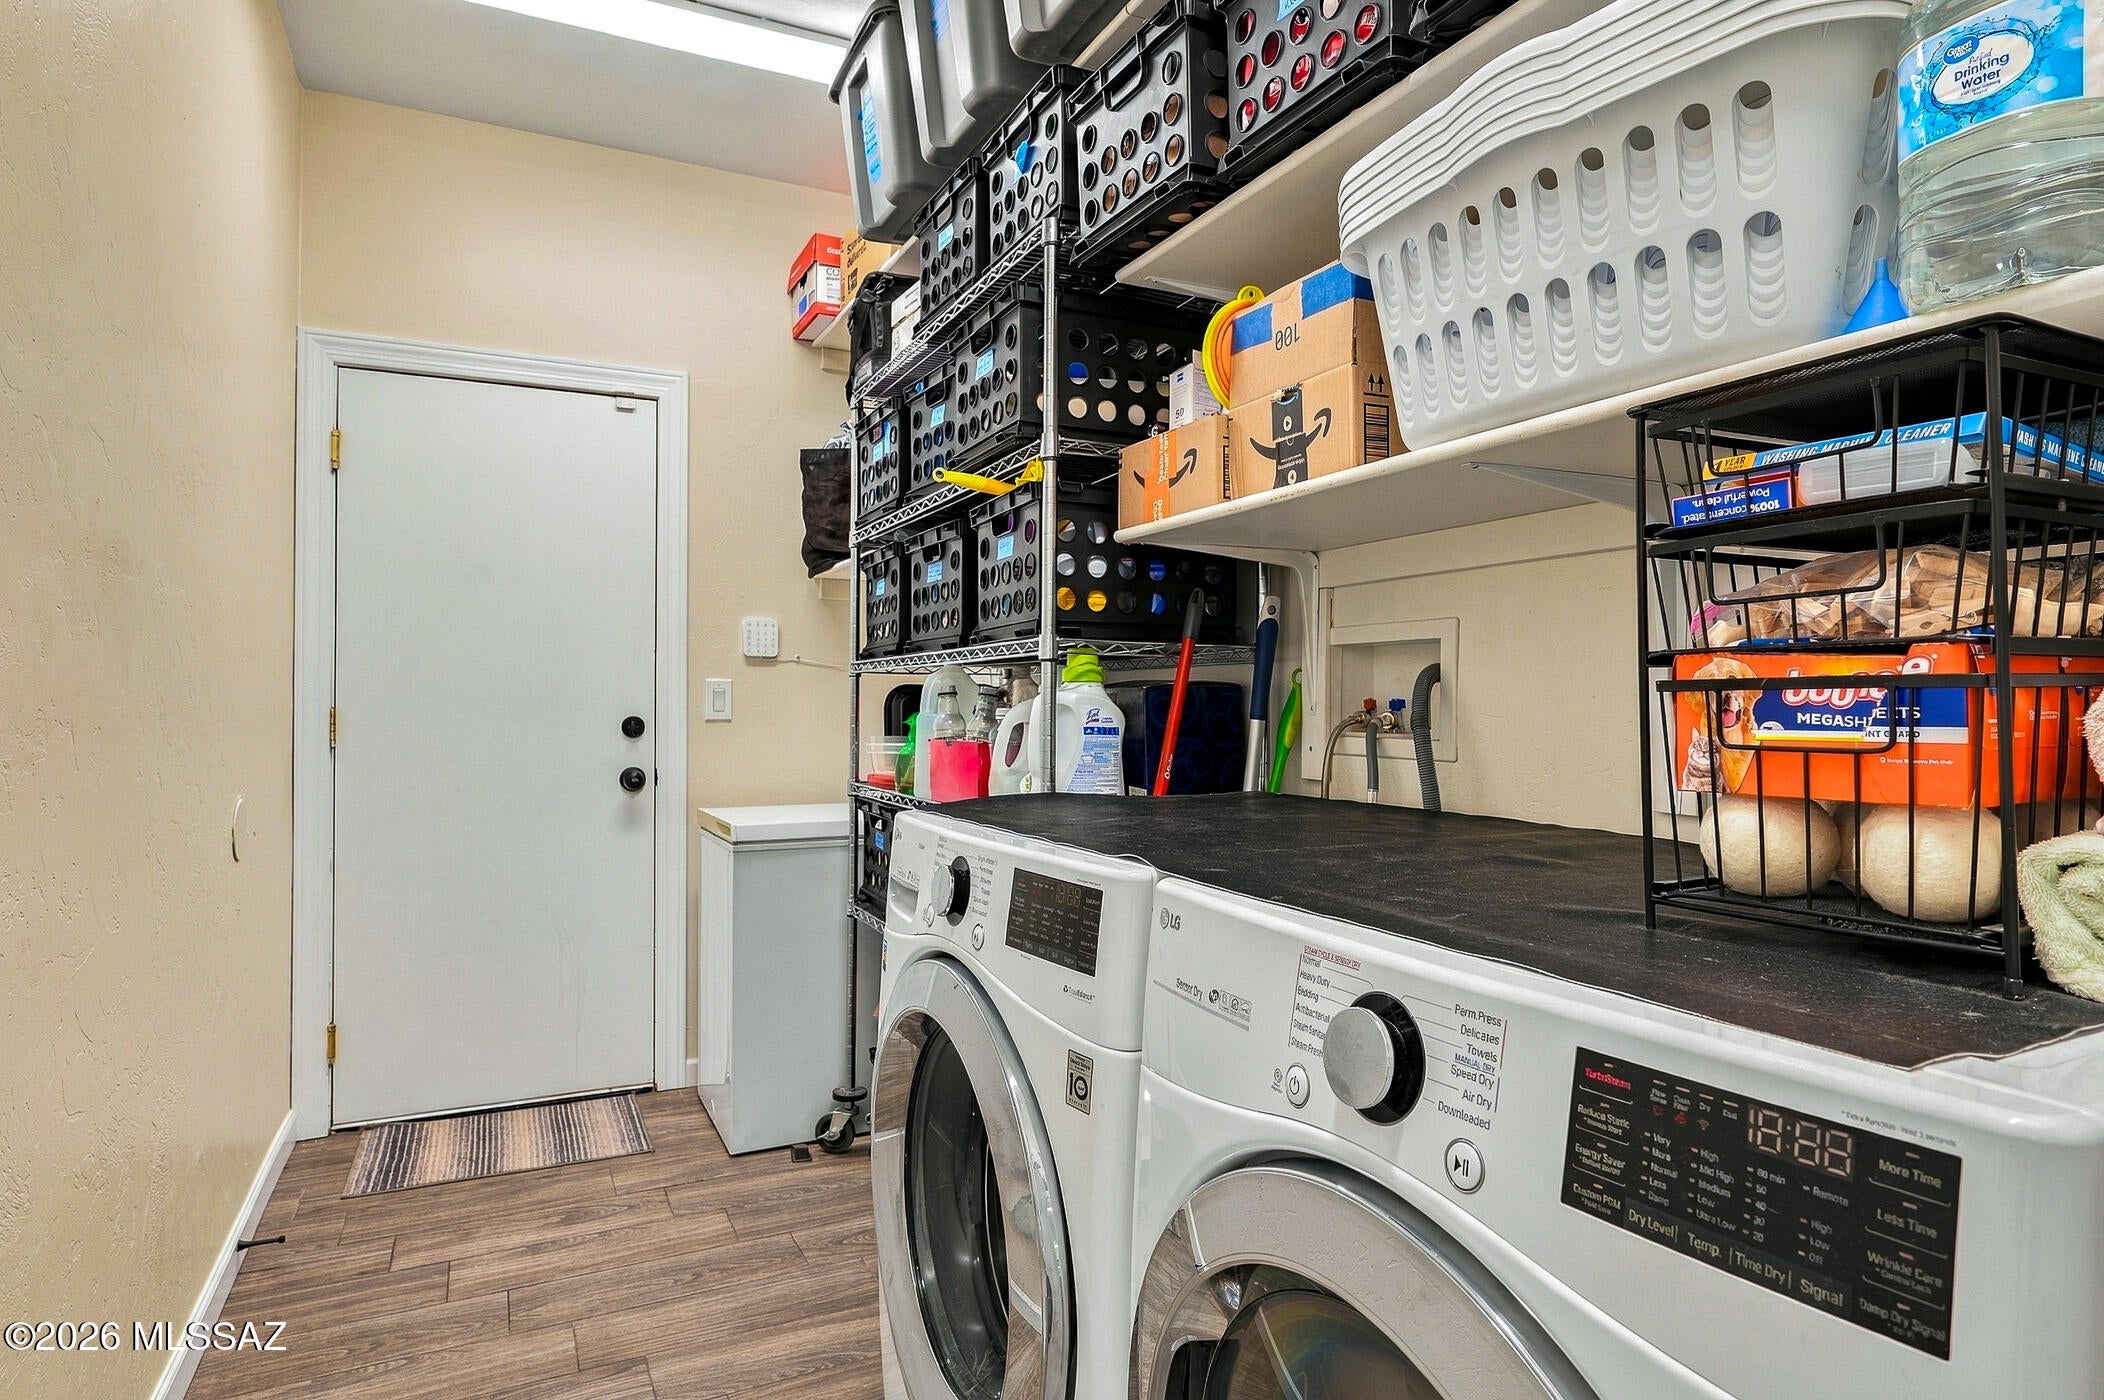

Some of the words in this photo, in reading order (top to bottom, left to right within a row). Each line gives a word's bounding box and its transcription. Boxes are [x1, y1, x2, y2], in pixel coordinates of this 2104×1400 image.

[1946, 40, 1973, 56] Great
[1954, 53, 2010, 82] Drinking
[1961, 69, 2001, 90] Water
[1175, 408, 1185, 419] 50
[1723, 456, 1746, 467] YEAR
[1681, 505, 1747, 524] concentated.
[1750, 499, 1780, 513] 100%
[1884, 729, 1920, 738] GARD
[1170, 913, 1181, 931] LG
[1302, 954, 1321, 968] Normal
[1300, 970, 1316, 983] Heavy
[1316, 975, 1331, 988] Duty
[1297, 985, 1319, 1003] Bedding
[1295, 1002, 1331, 1023] Antibacterial
[1293, 1018, 1309, 1032] Steam
[1291, 1036, 1308, 1050] Steam
[1460, 1023, 1500, 1046] Delicates
[1466, 1042, 1498, 1063] Towels
[1454, 1052, 1481, 1069] MANUAL
[1482, 1062, 1496, 1074] DRY
[1450, 1063, 1477, 1082] Speed
[1479, 1073, 1495, 1090] Dry
[1069, 1072, 1088, 1101] 10
[1461, 1088, 1475, 1103] Air
[1476, 1093, 1493, 1111] Dry
[1437, 1100, 1491, 1131] Downloaded
[1577, 1103, 1606, 1122] Reduce
[1606, 1114, 1630, 1130] Static
[1652, 1132, 1672, 1148] Very
[1575, 1142, 1602, 1161] Energy
[1602, 1153, 1627, 1170] Saver
[1651, 1147, 1671, 1162] More
[1700, 1148, 1720, 1163] High
[1650, 1162, 1678, 1179] Normal
[1699, 1163, 1715, 1177] Mid
[1715, 1168, 1735, 1184] High
[1769, 1172, 1786, 1185] min
[1878, 1158, 1910, 1179] More
[1910, 1168, 1943, 1190] Time
[1649, 1176, 1668, 1191] Less
[1698, 1178, 1731, 1199] Medium
[1756, 1183, 1767, 1195] 50
[1573, 1182, 1601, 1203] Custom
[1601, 1194, 1621, 1210] PGM
[1647, 1190, 1670, 1207] Damp
[1697, 1193, 1716, 1209] Low
[1812, 1185, 1849, 1208] Remote
[1754, 1200, 1767, 1212] 40
[1695, 1208, 1716, 1225] Ultra
[1716, 1217, 1737, 1232] Low
[1753, 1214, 1766, 1227] 30
[1811, 1218, 1833, 1237] High
[1876, 1207, 1905, 1229] Less
[1906, 1217, 1939, 1240] Time
[1752, 1230, 1764, 1243] 20
[1809, 1235, 1831, 1251] Low
[1628, 1208, 1647, 1229] Dry
[1647, 1216, 1675, 1240] Level
[1687, 1231, 1722, 1258] Temp.
[1735, 1250, 1762, 1274] Time
[1764, 1263, 1787, 1285] Dry
[1800, 1277, 1845, 1308] Signal
[1808, 1251, 1824, 1266] Off
[1867, 1250, 1912, 1278] Wrinkle
[1913, 1267, 1944, 1289] Care
[1859, 1297, 1888, 1320] Damp
[1890, 1309, 1911, 1330] Dry
[1911, 1318, 1947, 1343] Signal
